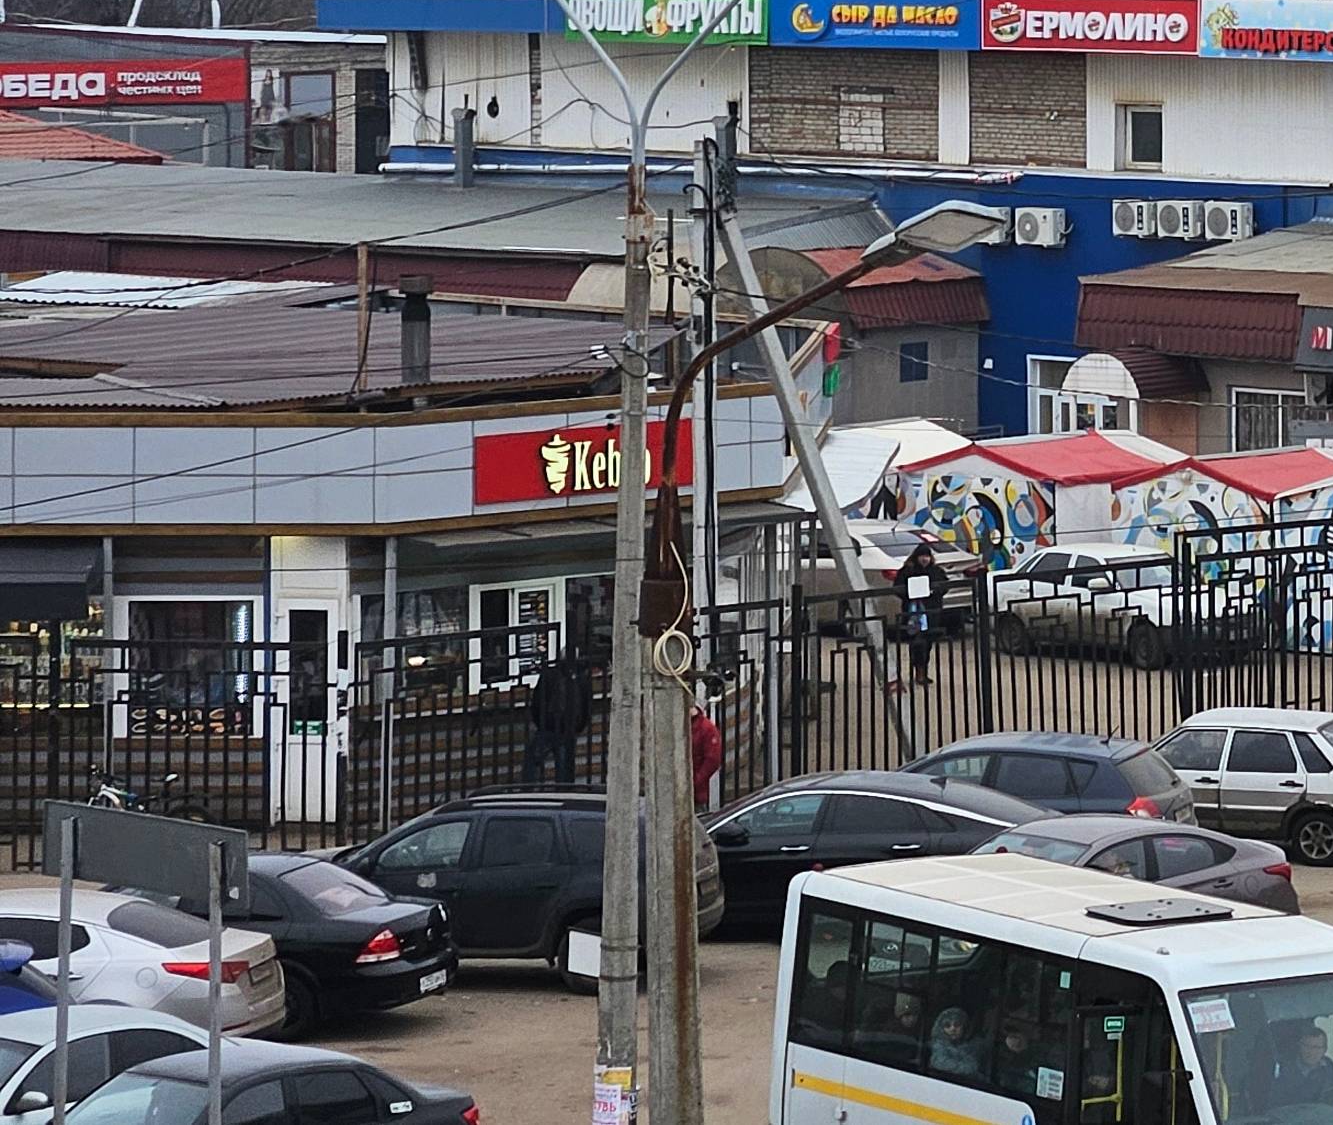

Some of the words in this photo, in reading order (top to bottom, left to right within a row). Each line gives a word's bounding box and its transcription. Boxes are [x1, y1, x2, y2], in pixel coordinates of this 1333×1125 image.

[832, 4, 870, 23] СЫР
[873, 5, 897, 27] ДА
[902, 5, 959, 25] МАСЛО
[1026, 10, 1189, 43] ЕРМОЛИНО
[0, 72, 106, 101] БЕДА
[574, 438, 651, 491] Keb
